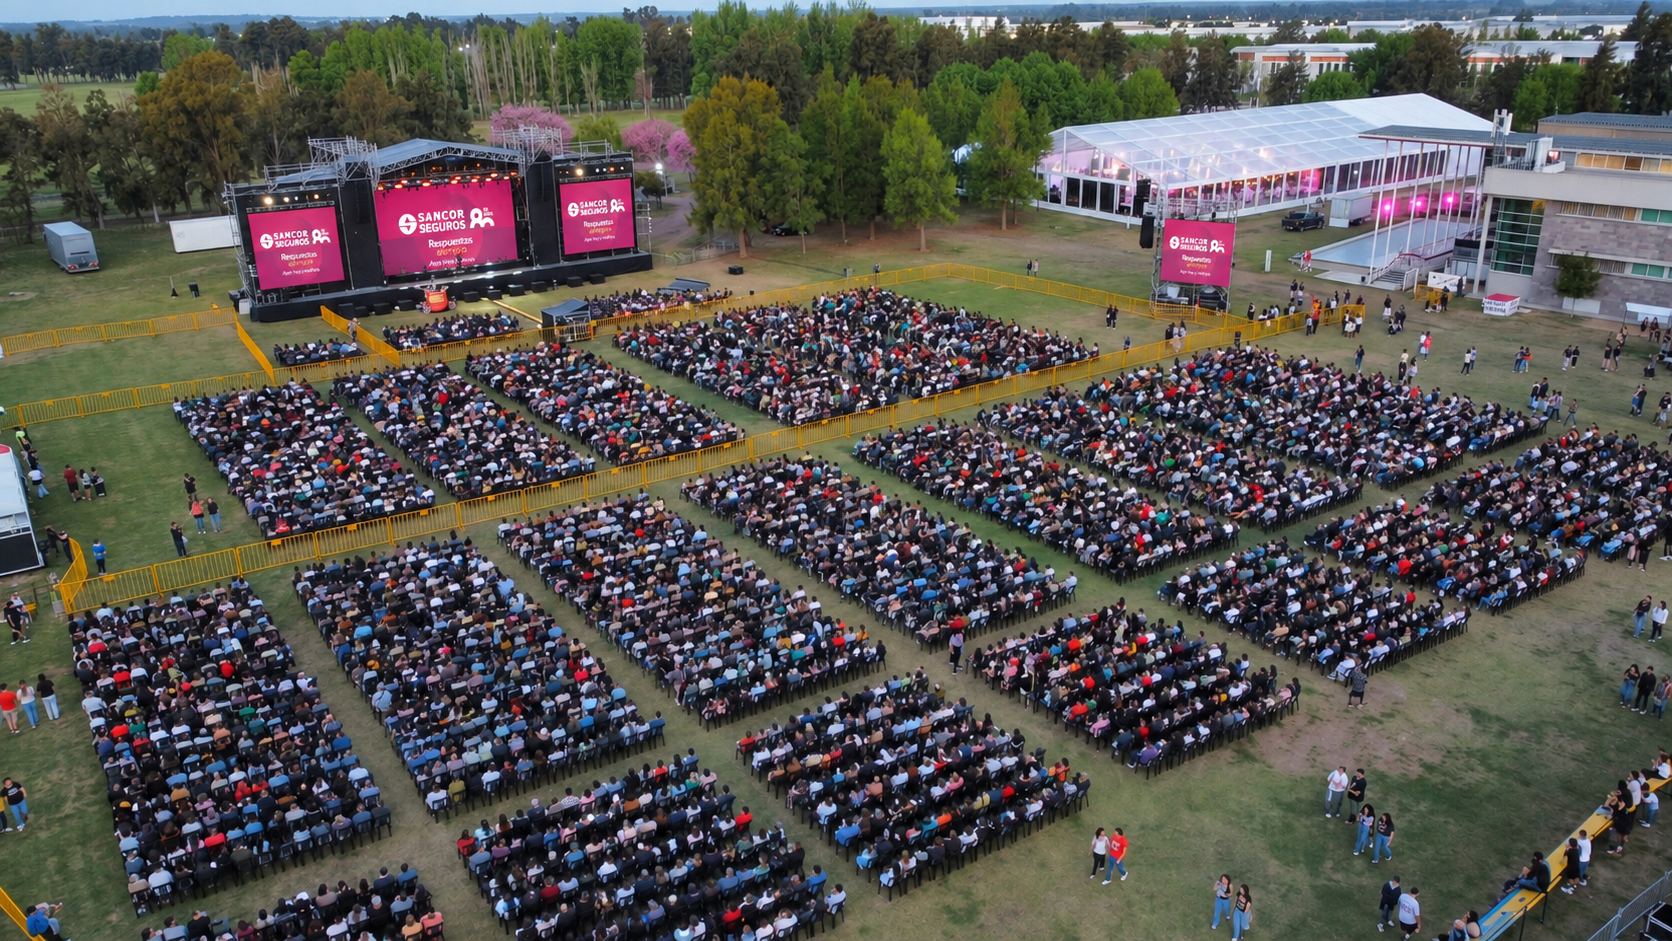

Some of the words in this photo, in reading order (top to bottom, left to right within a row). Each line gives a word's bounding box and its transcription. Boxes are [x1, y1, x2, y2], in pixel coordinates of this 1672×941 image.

[580, 200, 608, 208] SANCOR
[418, 209, 465, 223] SANCOR
[419, 220, 466, 234] SEGUROS
[273, 230, 309, 240] SANCOR
[275, 238, 310, 248] SEGUROS
